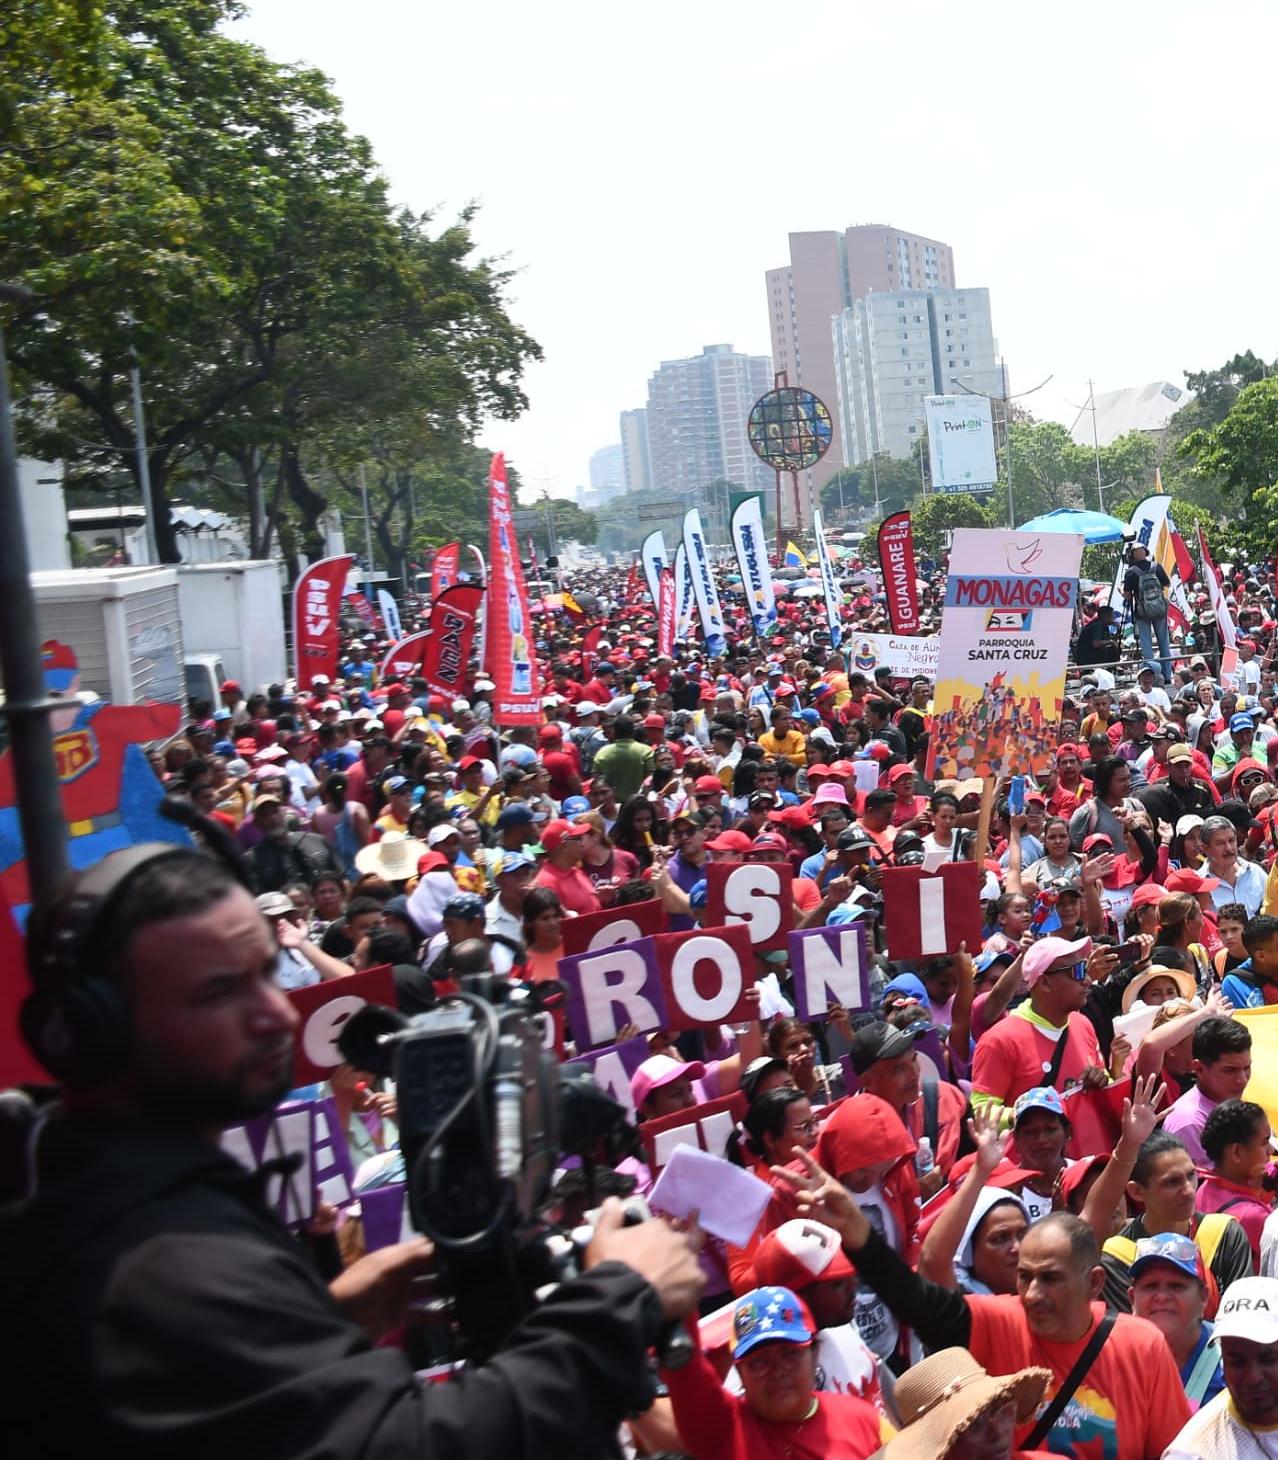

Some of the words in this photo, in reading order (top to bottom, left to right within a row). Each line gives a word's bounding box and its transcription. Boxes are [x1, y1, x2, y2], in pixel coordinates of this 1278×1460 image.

[889, 542, 913, 620] GUANARE
[956, 578, 1072, 608] MONAGAS
[968, 650, 1010, 660] SANTA
[1014, 650, 1048, 660] CRUZ
[979, 639, 1035, 649] PARROQUIA
[724, 864, 781, 944] S
[578, 948, 661, 1046] R
[671, 935, 742, 1022] O
[803, 929, 862, 1016] N
